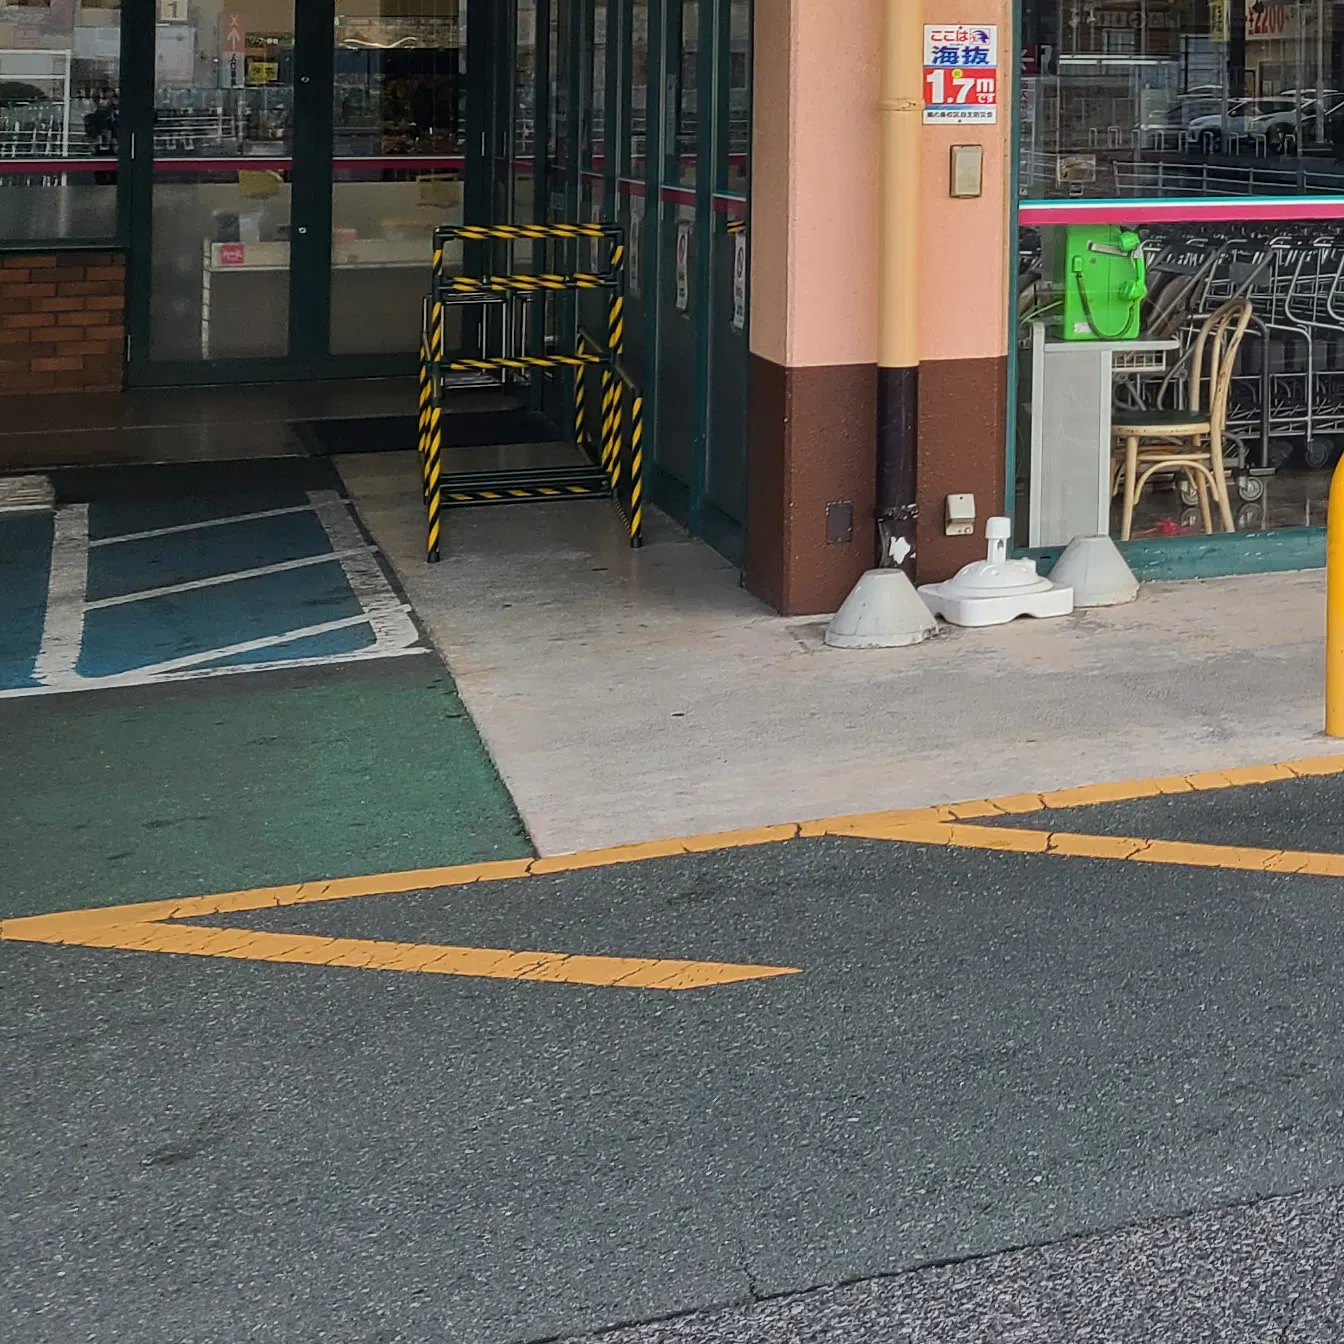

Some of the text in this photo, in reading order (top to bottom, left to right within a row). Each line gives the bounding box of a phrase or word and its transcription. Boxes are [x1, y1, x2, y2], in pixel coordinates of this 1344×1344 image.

[930, 29, 969, 42] ここは
[930, 45, 990, 65] 海抜
